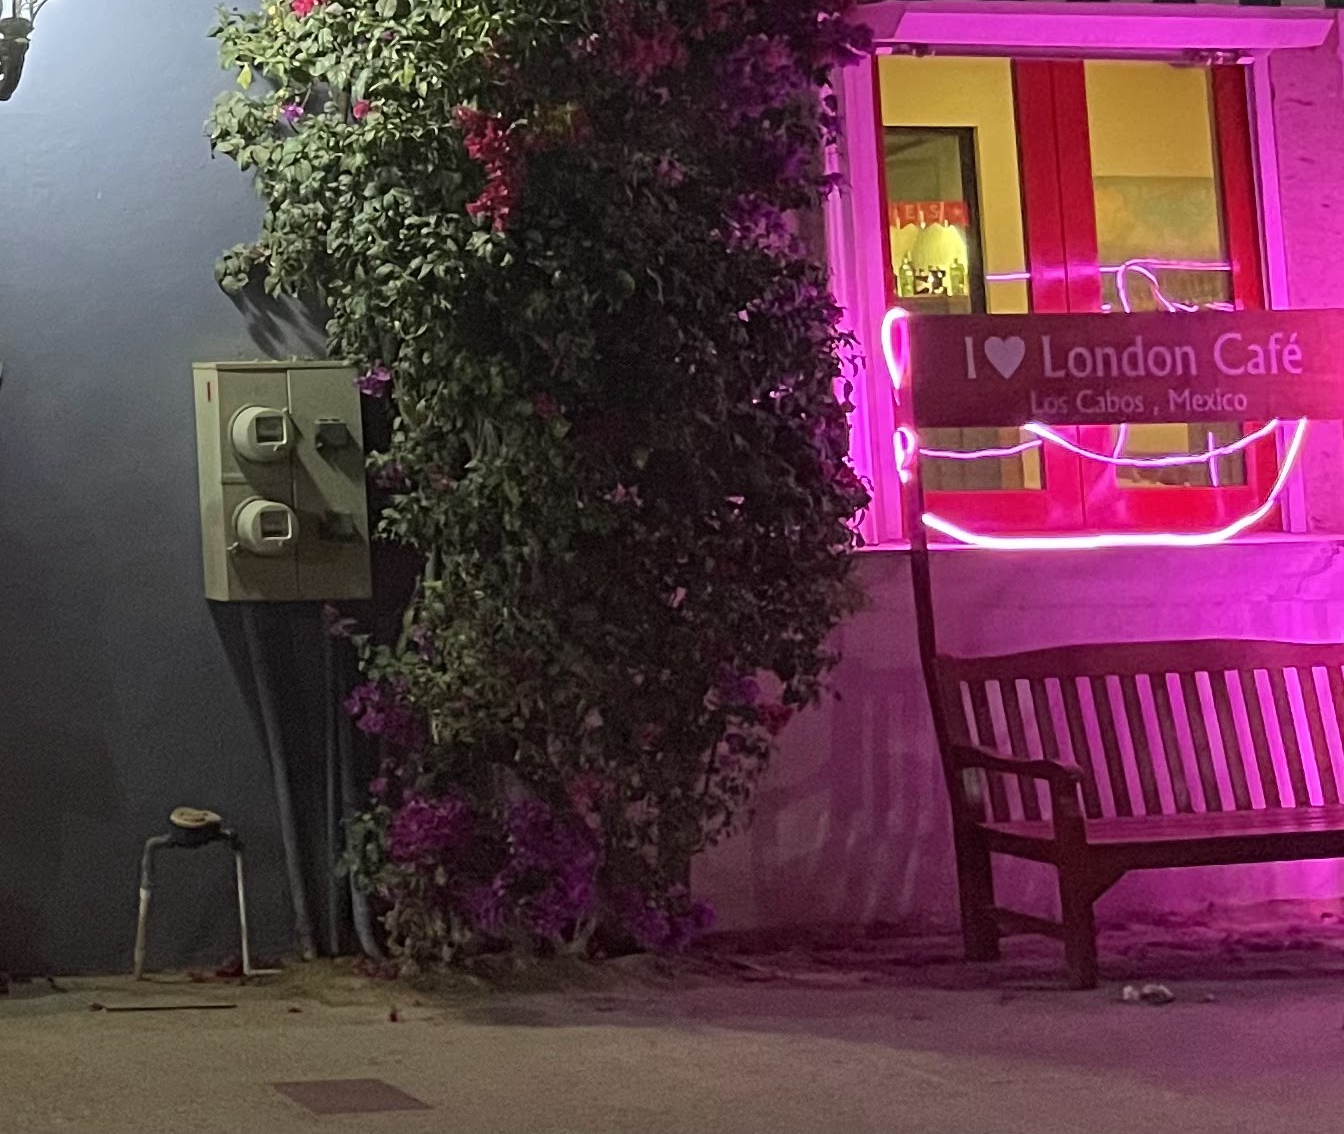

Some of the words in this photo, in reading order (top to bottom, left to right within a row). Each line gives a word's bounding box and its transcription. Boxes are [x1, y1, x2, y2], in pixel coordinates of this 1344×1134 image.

[964, 336, 977, 379] I
[1041, 335, 1196, 378] London
[1213, 332, 1303, 376] Café
[1030, 390, 1069, 415] Los
[1168, 387, 1248, 412] Mexico
